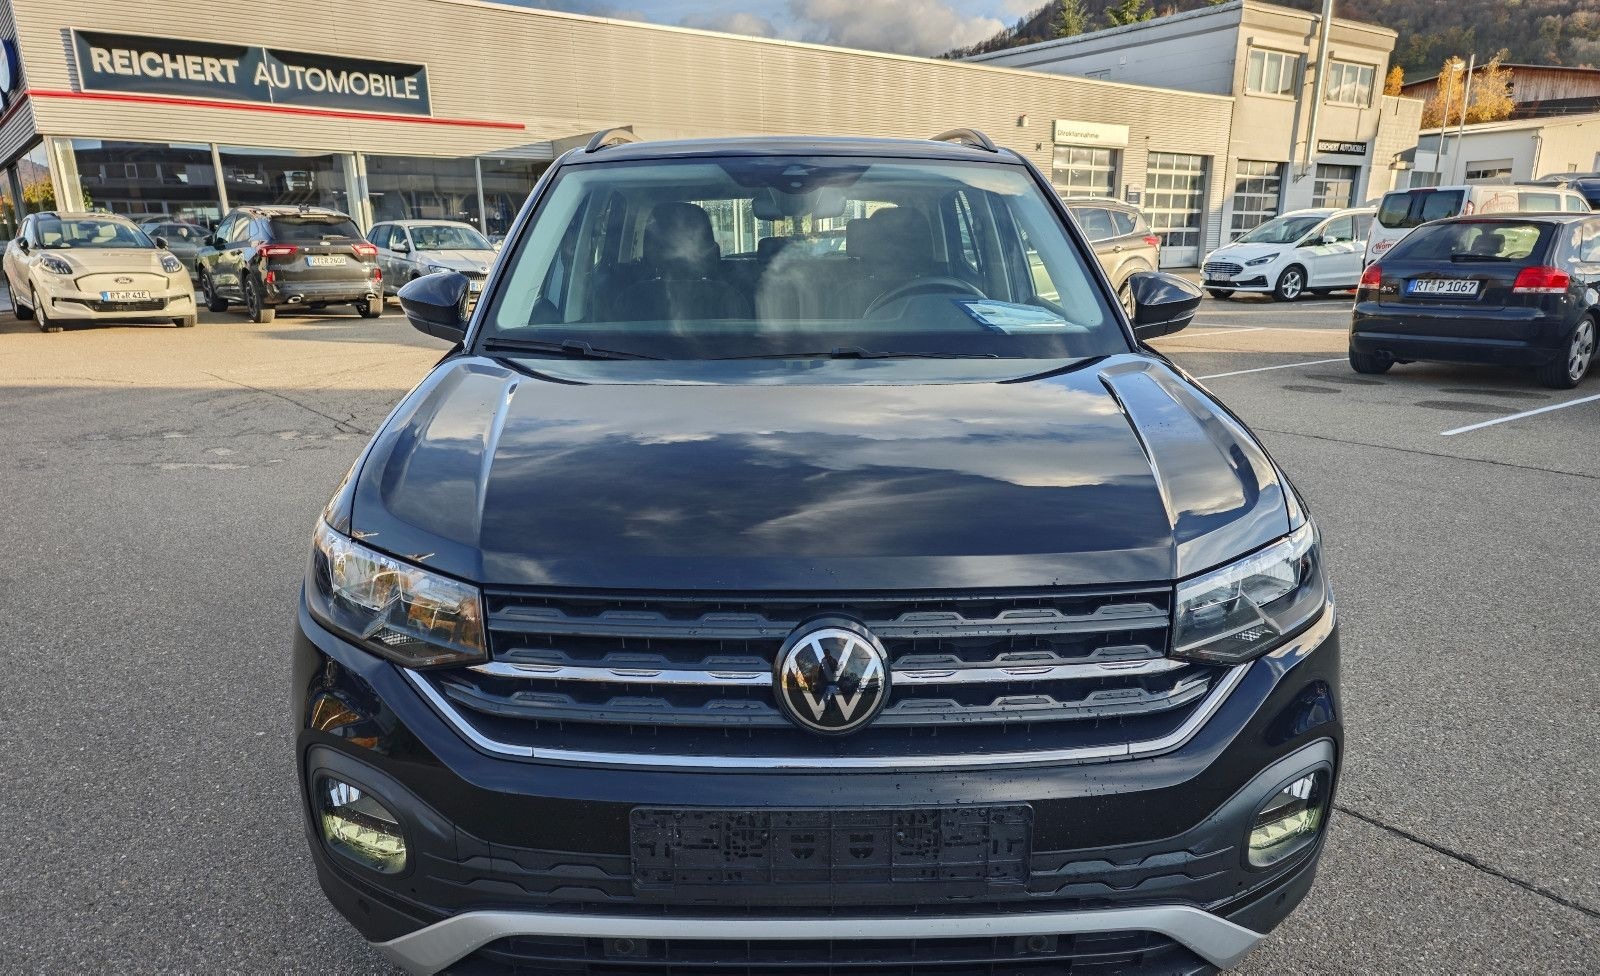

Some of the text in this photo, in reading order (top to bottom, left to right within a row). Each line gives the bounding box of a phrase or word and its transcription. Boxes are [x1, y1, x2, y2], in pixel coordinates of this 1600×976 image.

[89, 47, 420, 100] REICHERT AUTOMOBILE
[1414, 279, 1477, 293] RT P 1067
